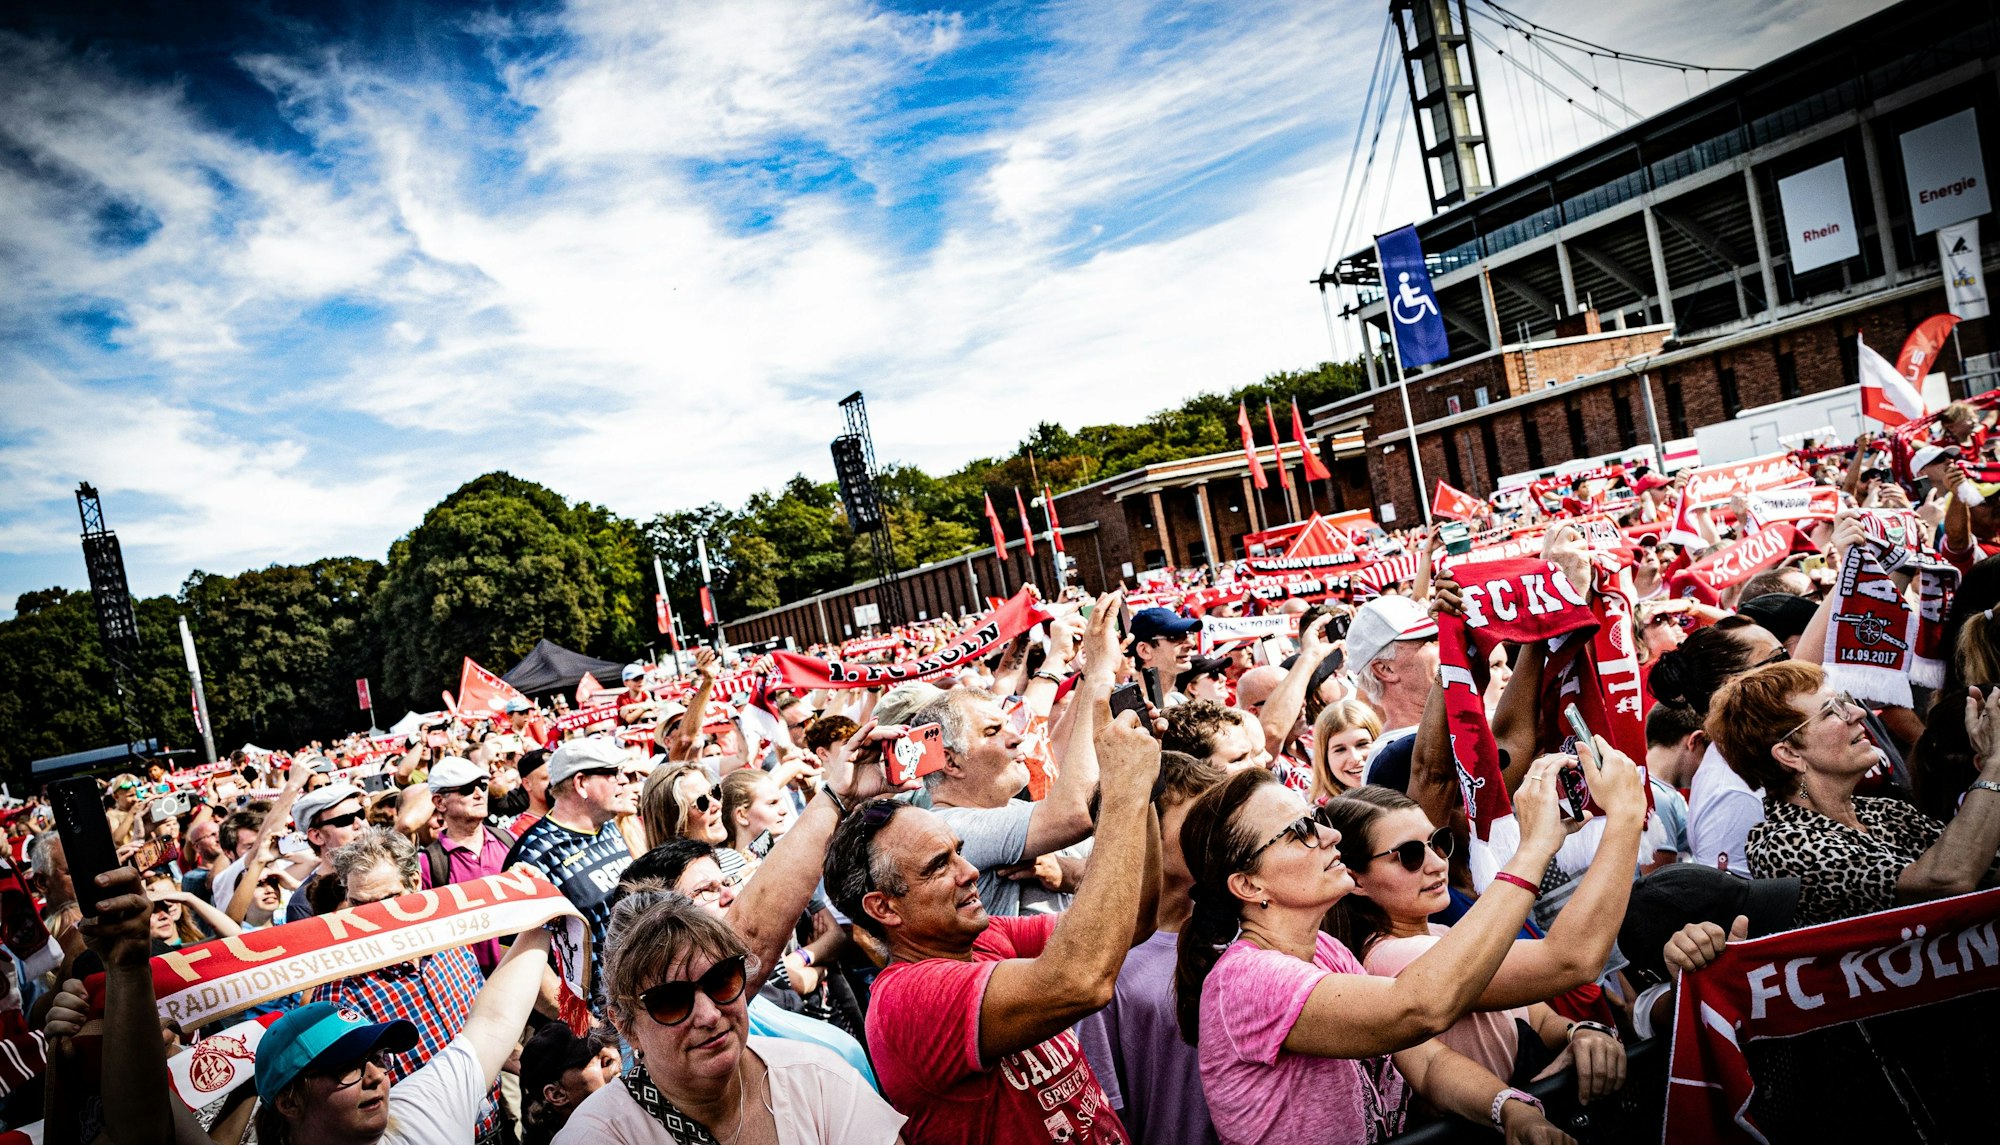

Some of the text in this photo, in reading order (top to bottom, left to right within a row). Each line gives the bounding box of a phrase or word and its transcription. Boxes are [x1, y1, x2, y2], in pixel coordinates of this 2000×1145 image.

[1918, 176, 1977, 204] Energie
[1803, 222, 1840, 242] Rhein
[1217, 582, 1244, 599] FC
[1286, 579, 1321, 595] BIN
[1325, 575, 1350, 590] FC
[1461, 578, 1518, 629] FC
[1840, 648, 1898, 664] 14.09.2017
[828, 661, 860, 682] 1.
[391, 925, 438, 952] SEIT
[446, 911, 491, 938] 1948
[1746, 921, 2000, 1019] FC KÖLN
[199, 1061, 222, 1085] 1.FC
[1043, 1076, 1076, 1105] SPICE
